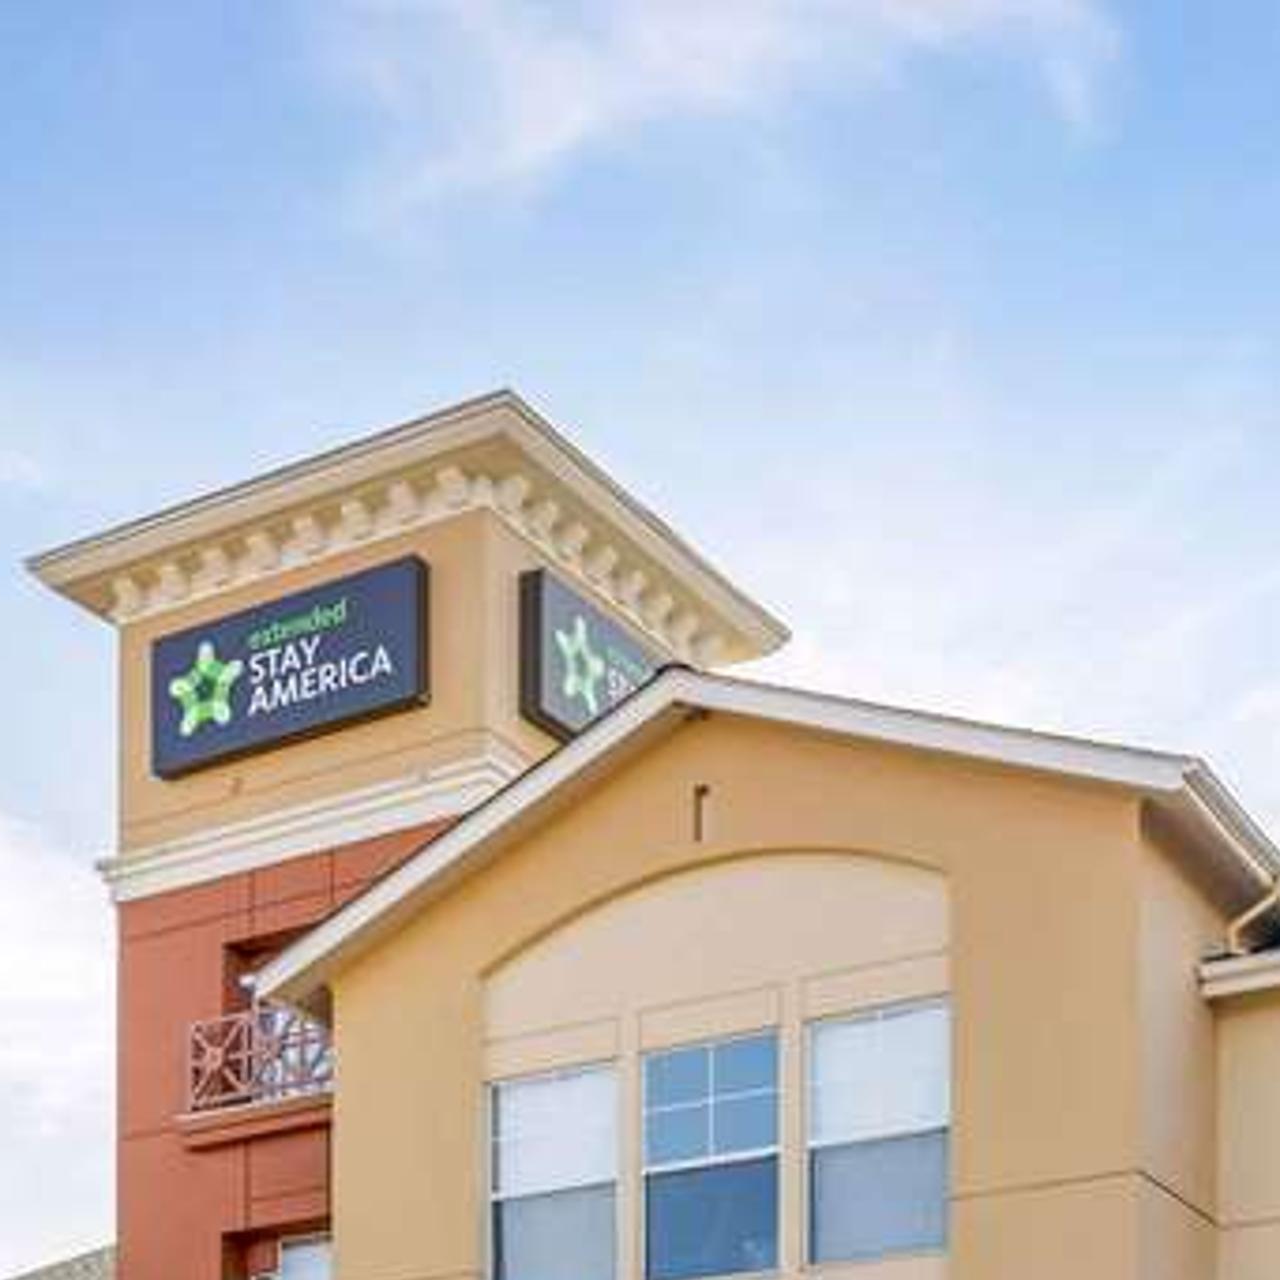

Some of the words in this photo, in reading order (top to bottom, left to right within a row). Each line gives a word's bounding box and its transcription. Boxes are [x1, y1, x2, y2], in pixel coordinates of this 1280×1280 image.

[249, 598, 347, 649] extended
[247, 643, 392, 716] AMERICA
[249, 634, 321, 684] STAY
